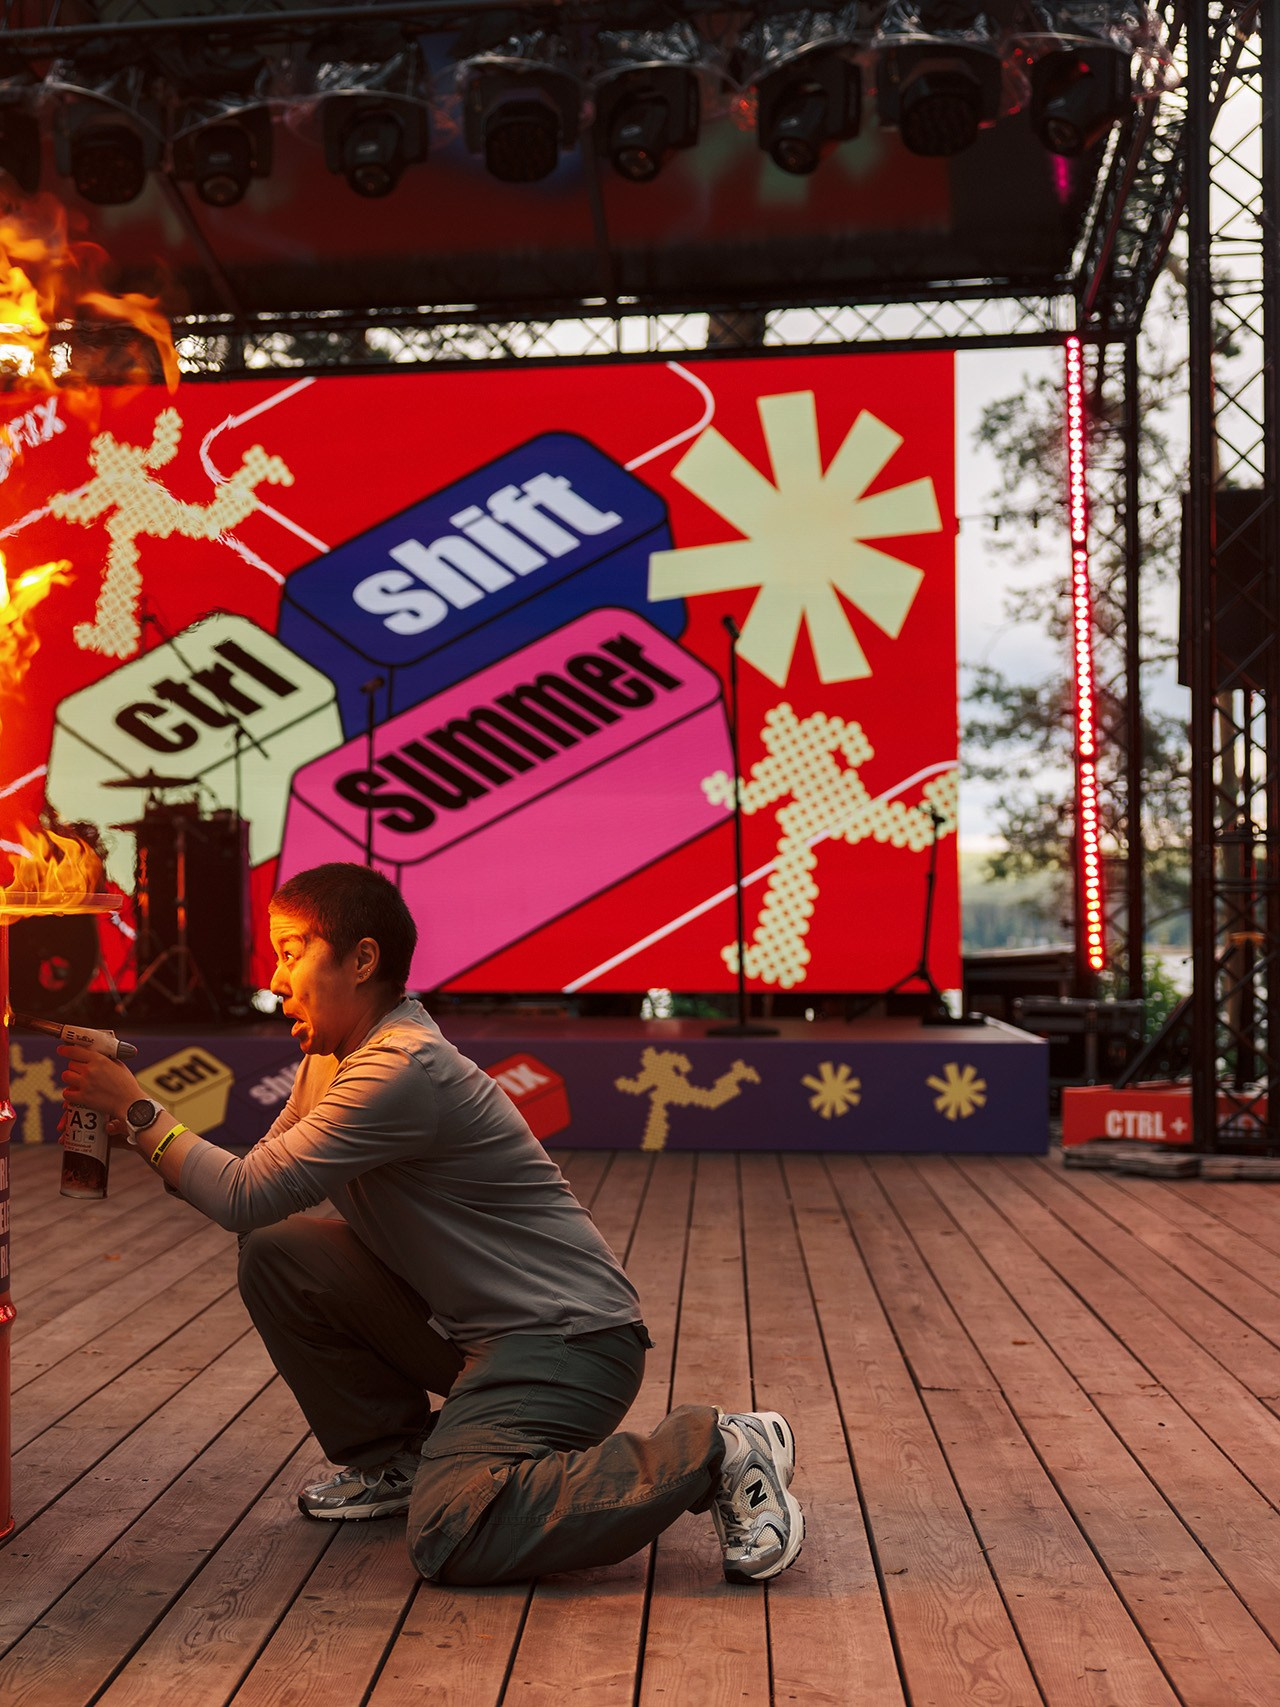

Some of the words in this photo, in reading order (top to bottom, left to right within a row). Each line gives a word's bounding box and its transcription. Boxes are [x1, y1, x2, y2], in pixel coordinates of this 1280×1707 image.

[351, 471, 623, 636] shift
[113, 637, 301, 755] ctrl
[332, 630, 686, 835] summer
[155, 1054, 219, 1094] ctrl
[1105, 1110, 1167, 1139] CTRL
